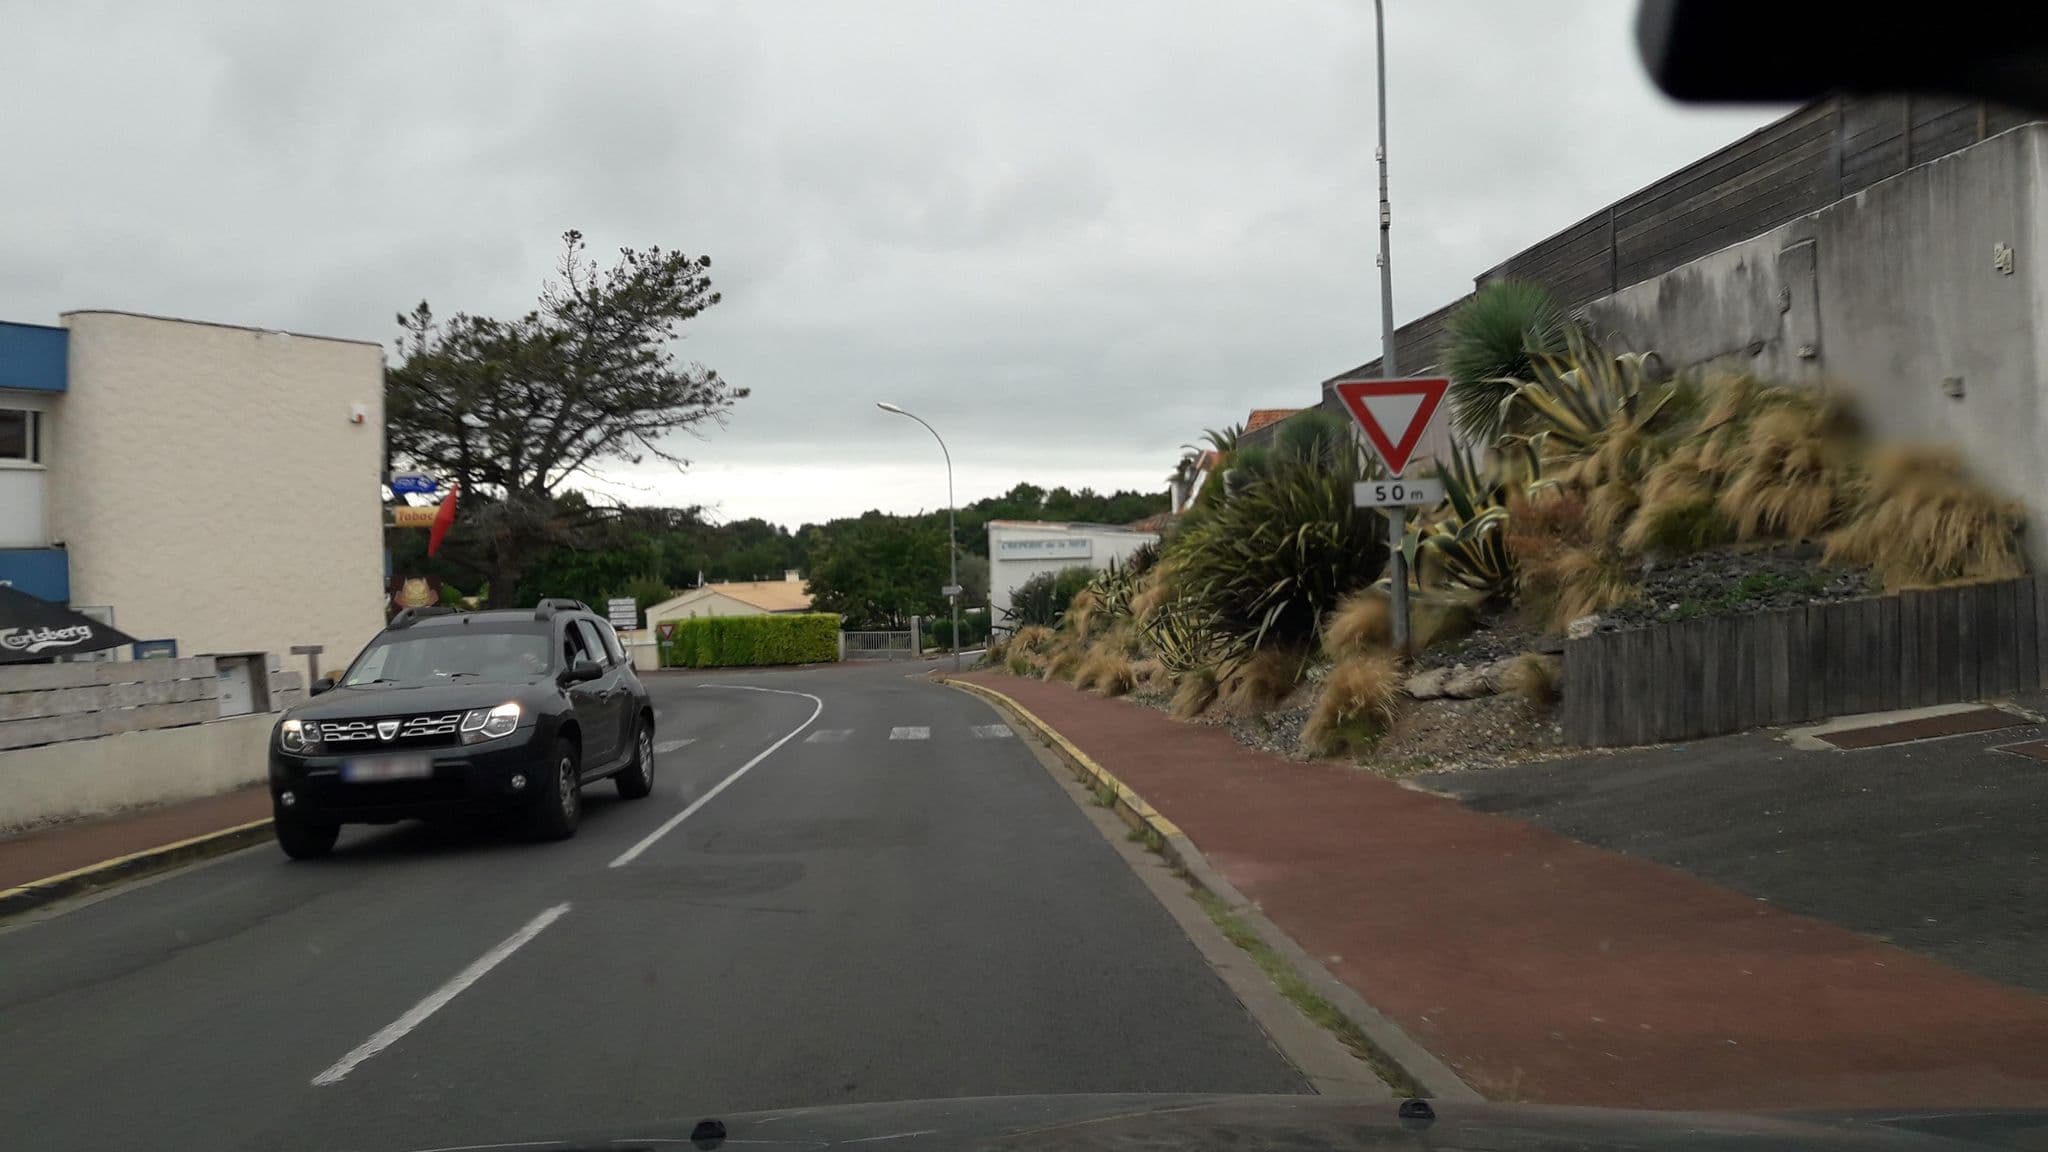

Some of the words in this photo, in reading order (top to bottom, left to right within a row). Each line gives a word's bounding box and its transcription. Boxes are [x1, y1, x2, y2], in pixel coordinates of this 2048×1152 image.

[1376, 485, 1404, 501] 50
[1411, 490, 1423, 499] m
[399, 511, 433, 521] Tabac
[0, 625, 93, 651] Carlsberg
